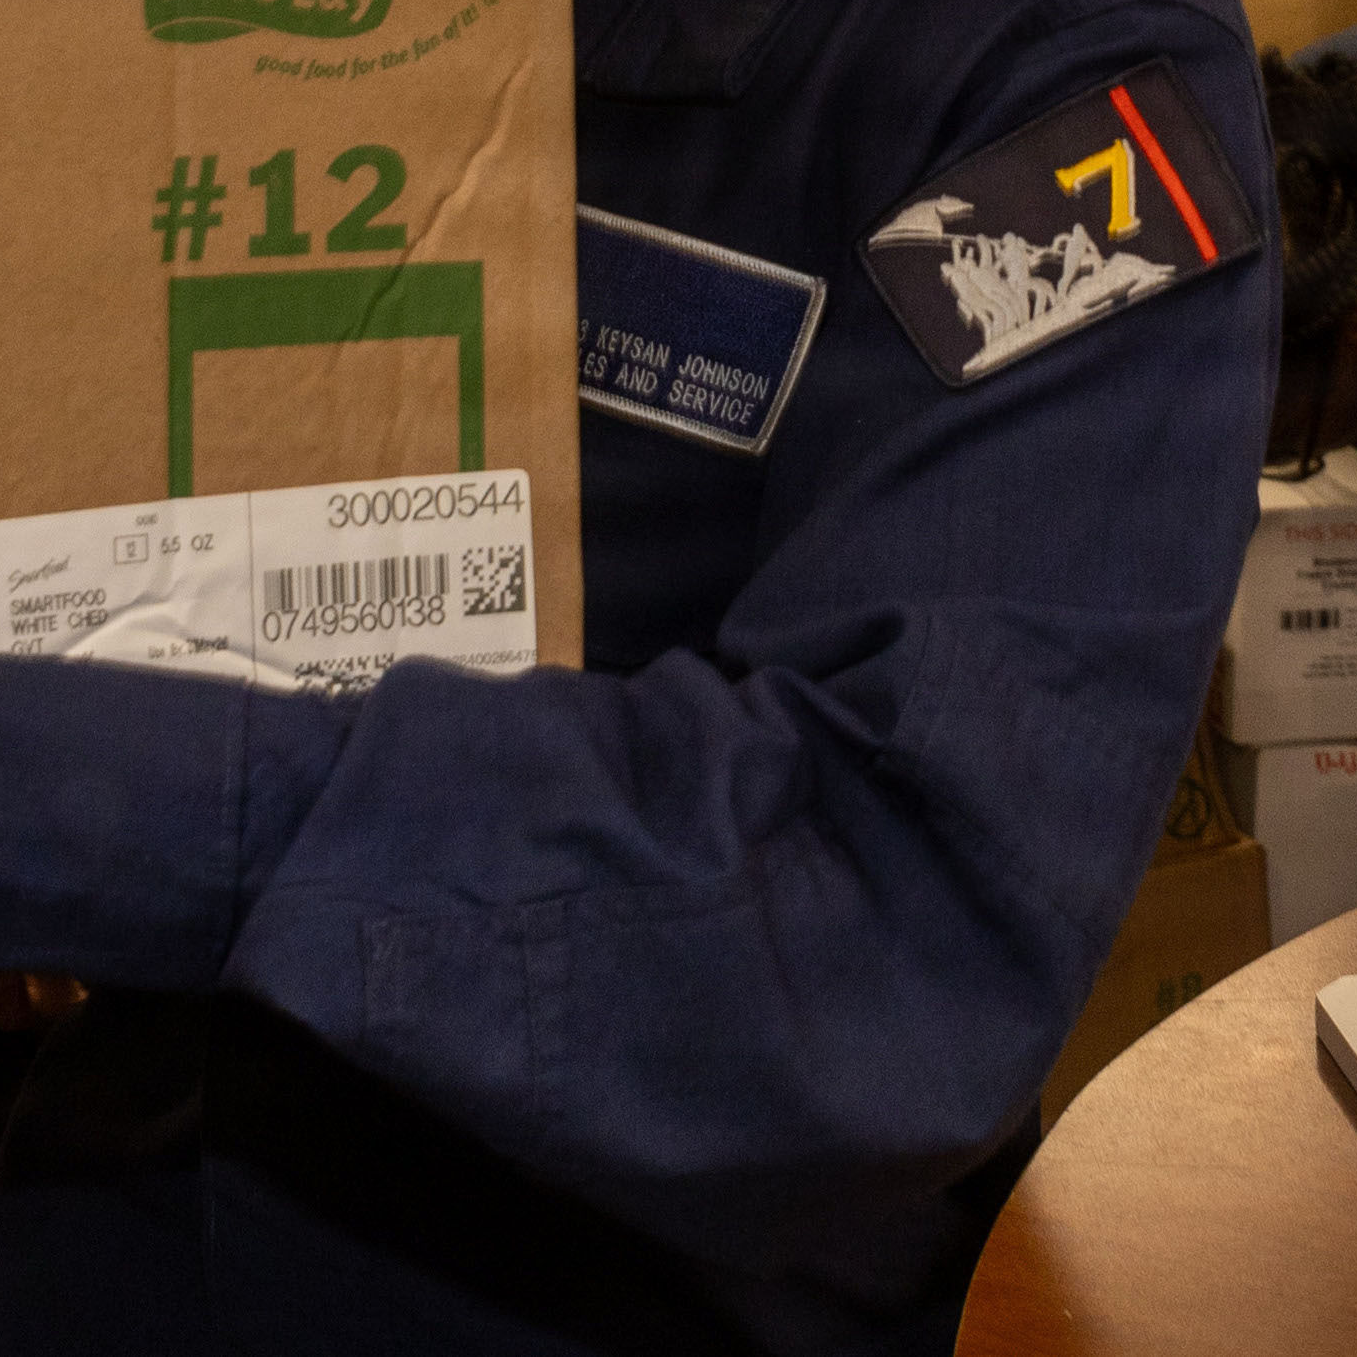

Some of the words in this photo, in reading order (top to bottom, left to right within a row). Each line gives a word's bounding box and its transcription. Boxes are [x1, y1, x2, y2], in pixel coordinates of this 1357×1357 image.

[151, 143, 408, 264] #12
[1054, 137, 1142, 240] 7
[596, 324, 671, 369] KEYSAN
[677, 352, 771, 400] JOHNSON
[615, 361, 659, 395] AND
[668, 378, 756, 426] SERVICE
[327, 479, 525, 529] 300020544
[10, 587, 108, 616] SMARTFOOD
[11, 614, 58, 636] WHITE
[261, 594, 445, 643] 0749560138
